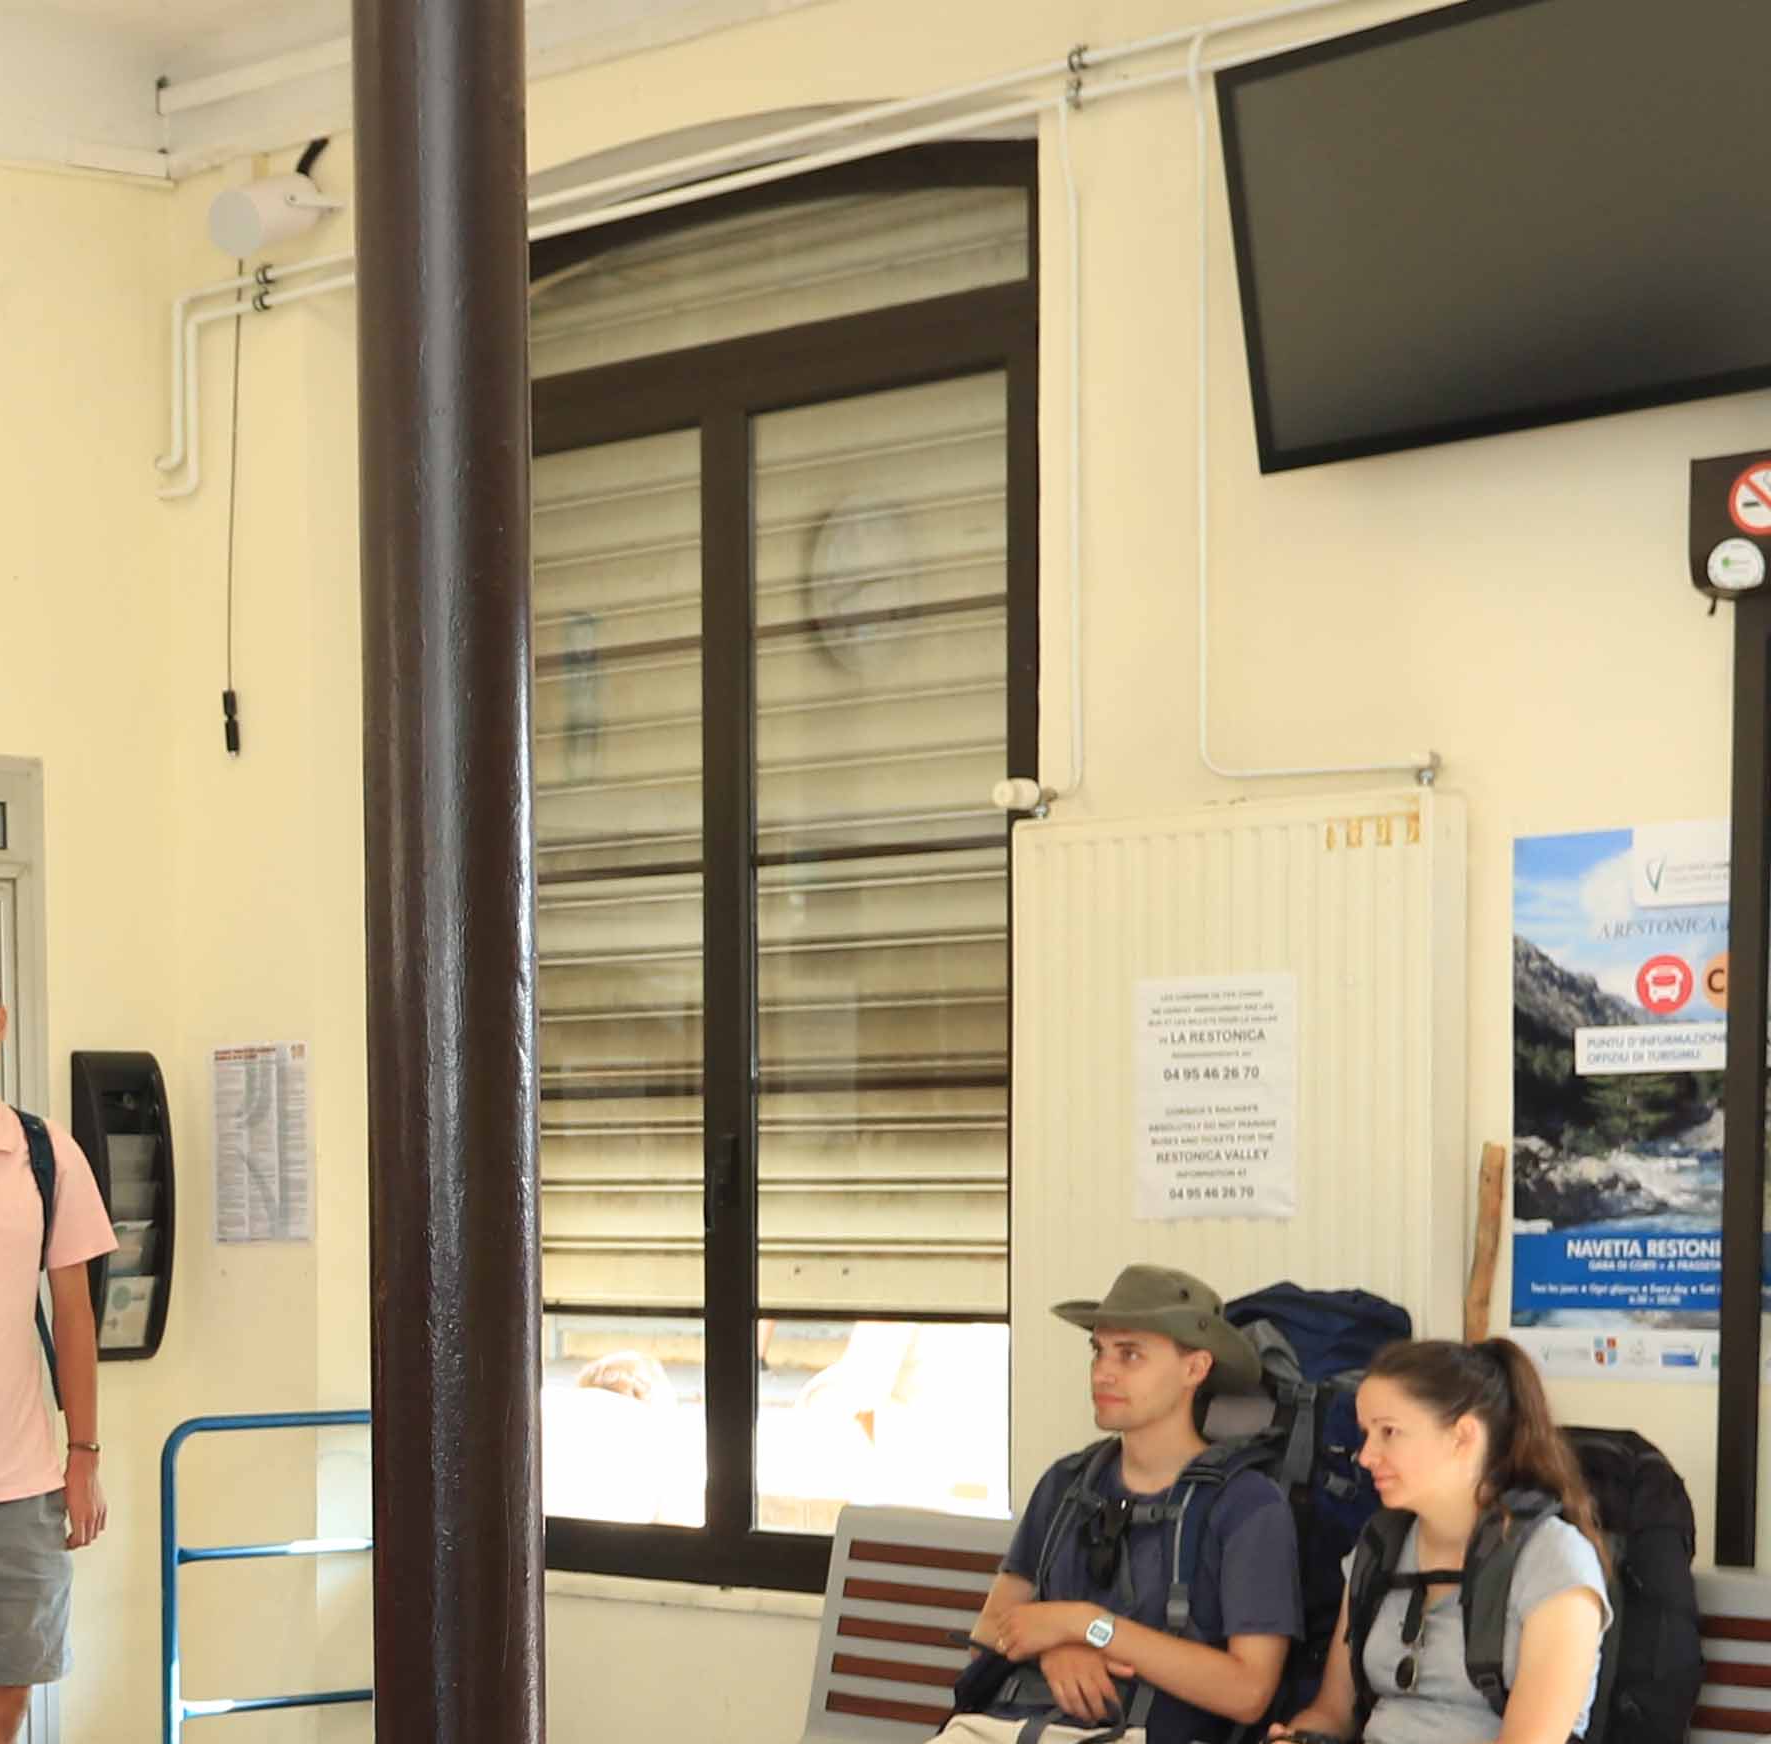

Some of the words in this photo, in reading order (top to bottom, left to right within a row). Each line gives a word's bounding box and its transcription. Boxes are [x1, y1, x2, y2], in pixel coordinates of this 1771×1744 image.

[1614, 913, 1716, 937] RESTONICA
[1170, 1032, 1187, 1045] LA
[1189, 1028, 1267, 1044] RESTONICA
[1162, 1069, 1180, 1082] 04
[1183, 1068, 1201, 1081] 95
[1203, 1067, 1220, 1080] 46
[1222, 1066, 1240, 1080] 26
[1242, 1065, 1260, 1079] 70
[1156, 1151, 1223, 1164] RESTONICA
[1224, 1149, 1269, 1161] VALLEY
[1168, 1188, 1184, 1200] 04
[1186, 1188, 1202, 1199] 95
[1204, 1187, 1219, 1199] 46
[1222, 1186, 1237, 1198] 26
[1239, 1186, 1255, 1198] 70
[1566, 1238, 1644, 1259] NAVETTA
[1588, 1260, 1616, 1272] GARA
